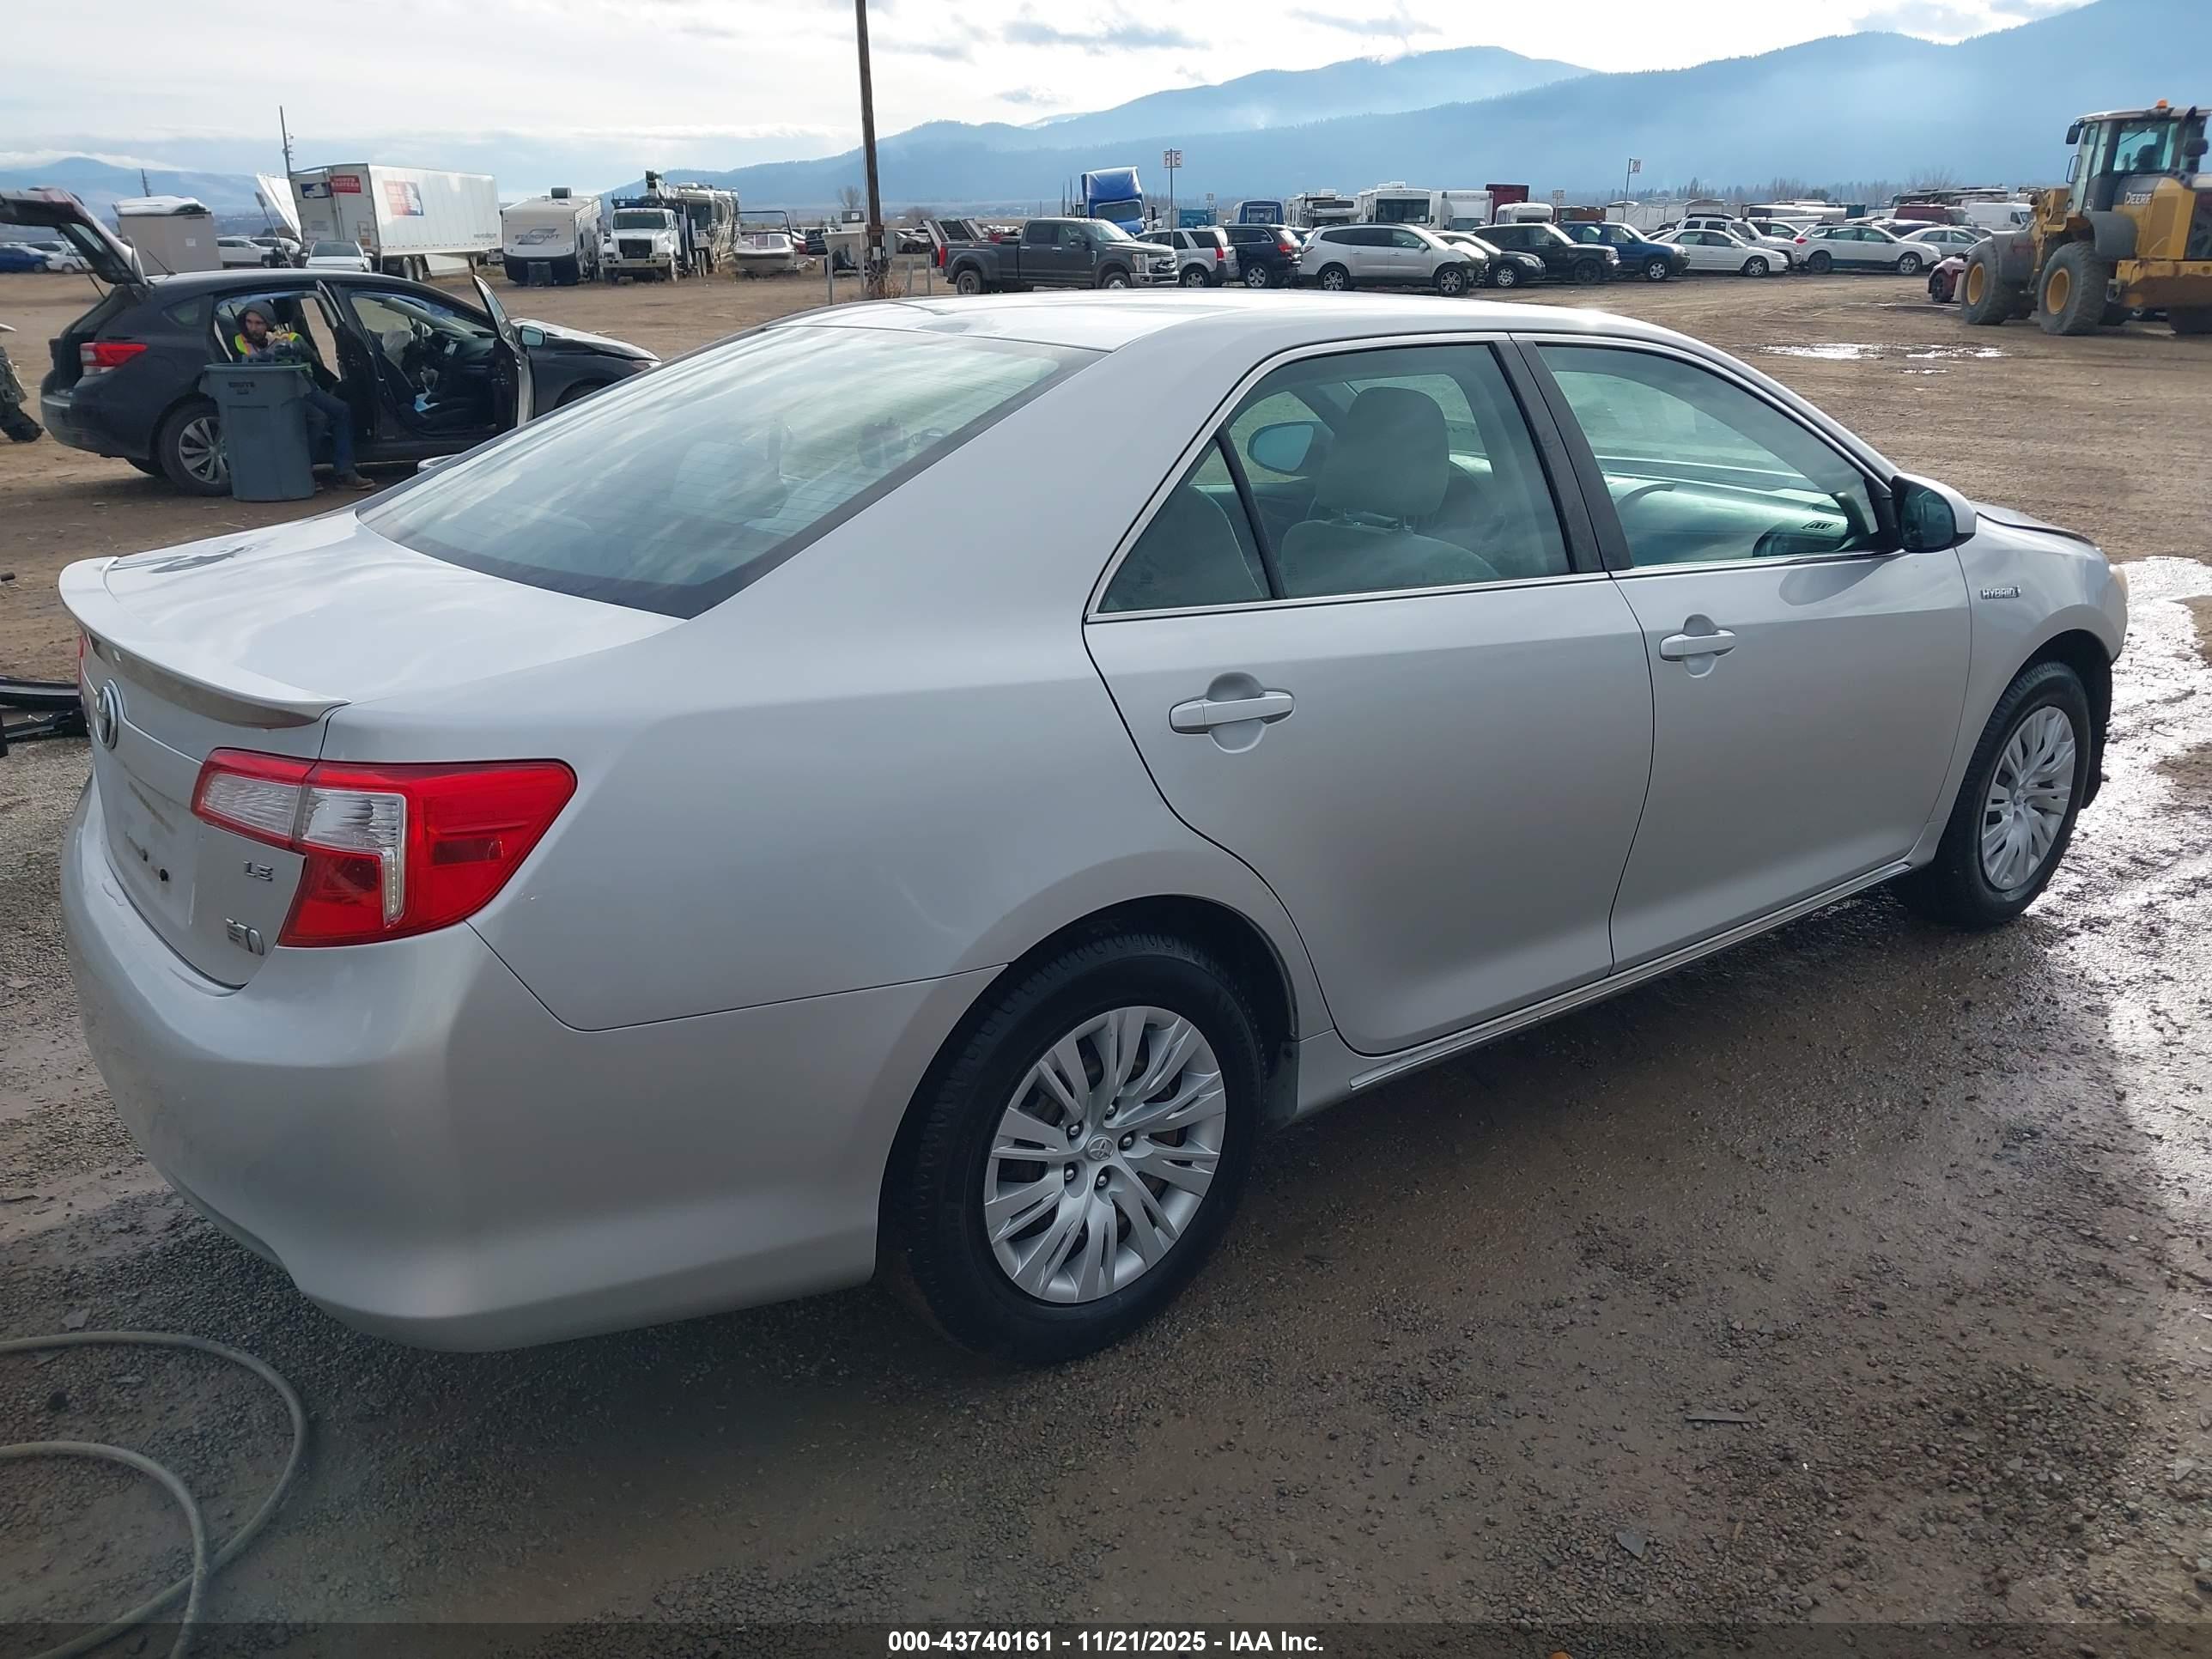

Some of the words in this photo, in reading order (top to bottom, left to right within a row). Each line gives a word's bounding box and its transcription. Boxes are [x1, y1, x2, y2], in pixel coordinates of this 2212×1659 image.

[1632, 161, 1641, 173] 20
[1981, 587, 2016, 599] HYBRID
[243, 860, 273, 882] LE
